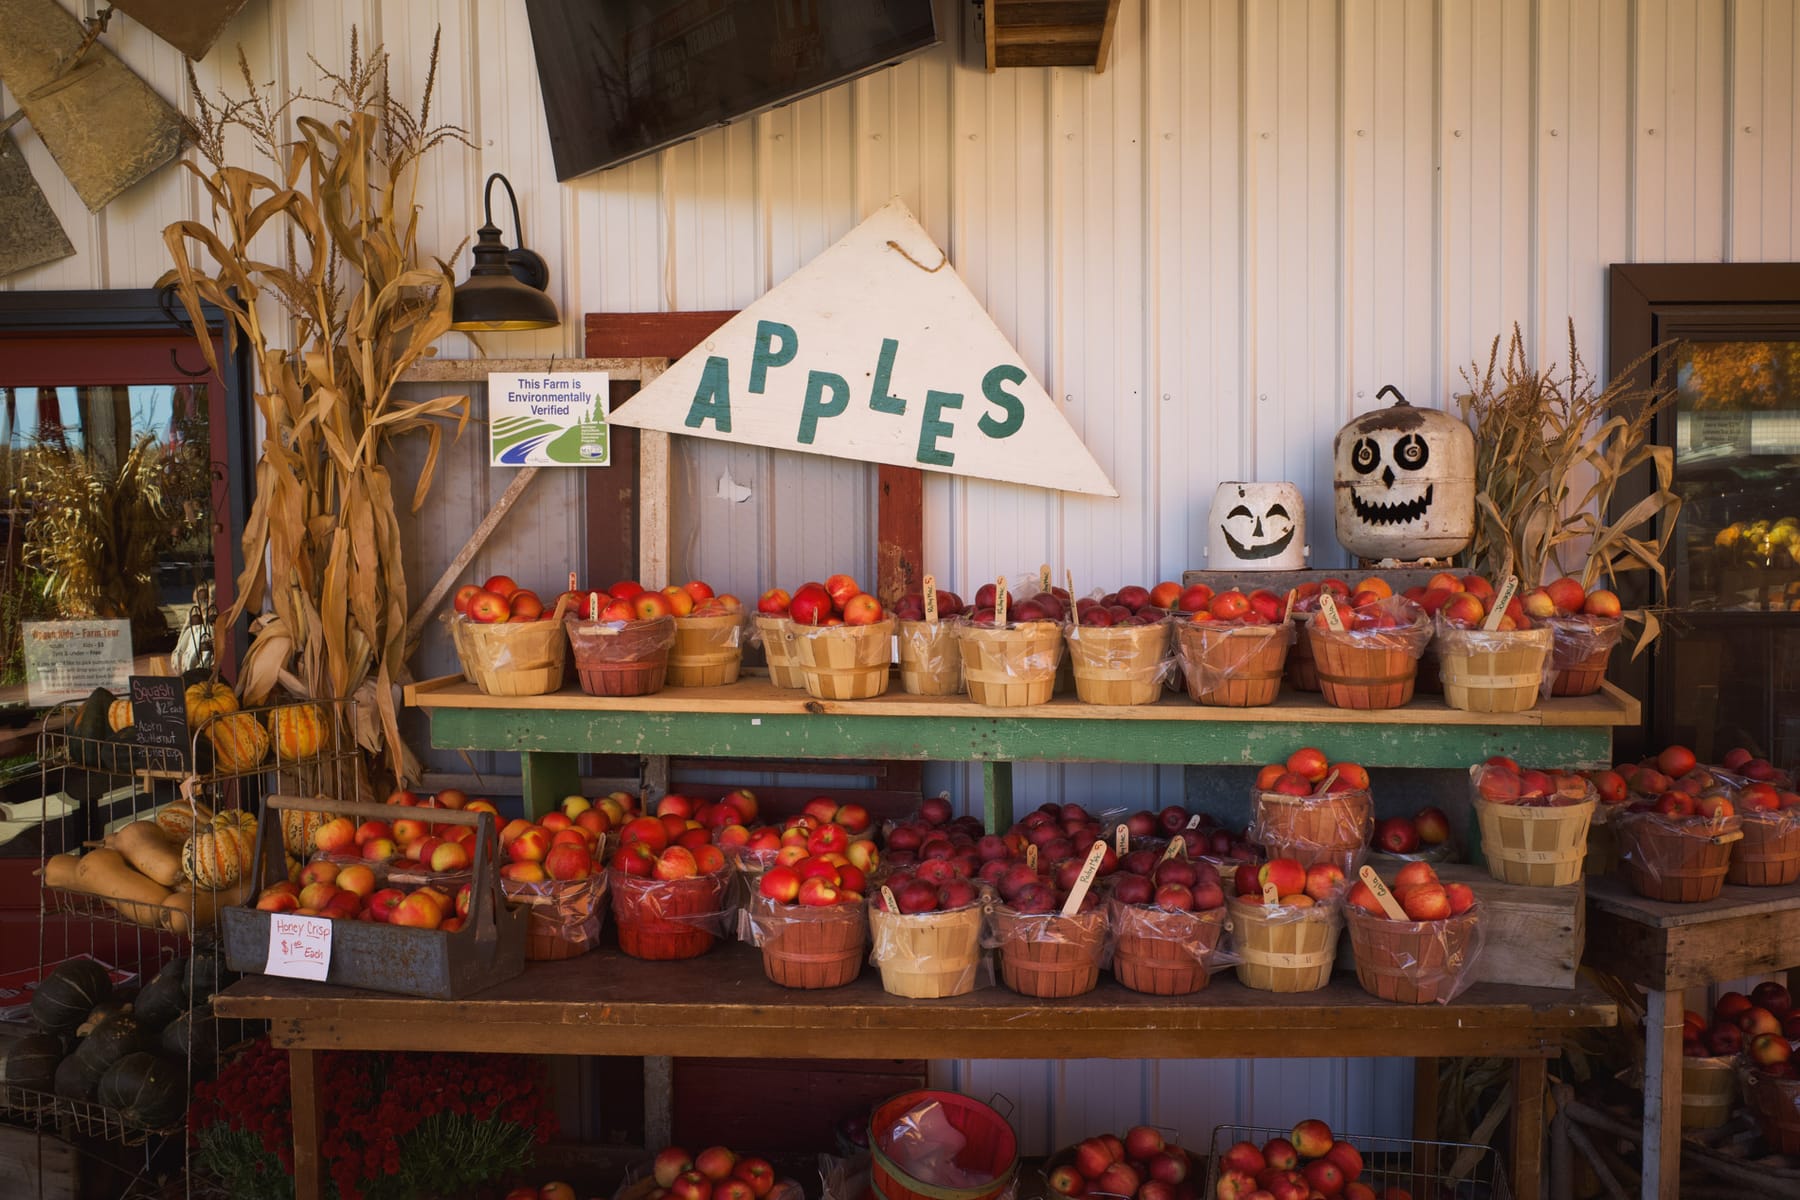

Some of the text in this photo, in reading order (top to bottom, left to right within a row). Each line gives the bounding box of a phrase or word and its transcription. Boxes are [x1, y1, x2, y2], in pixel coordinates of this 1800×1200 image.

[518, 378, 581, 390] This Farm is
[508, 392, 591, 404] Environmentally
[684, 319, 1027, 467] APPLES
[531, 405, 570, 416] Verified
[82, 628, 102, 638] Farm
[102, 628, 119, 638] Tour
[133, 680, 175, 704] Squash
[140, 720, 162, 732] Acorn
[1374, 878, 1386, 896] Gala
[277, 920, 330, 942] Honey Crisp
[304, 946, 324, 960] Each
